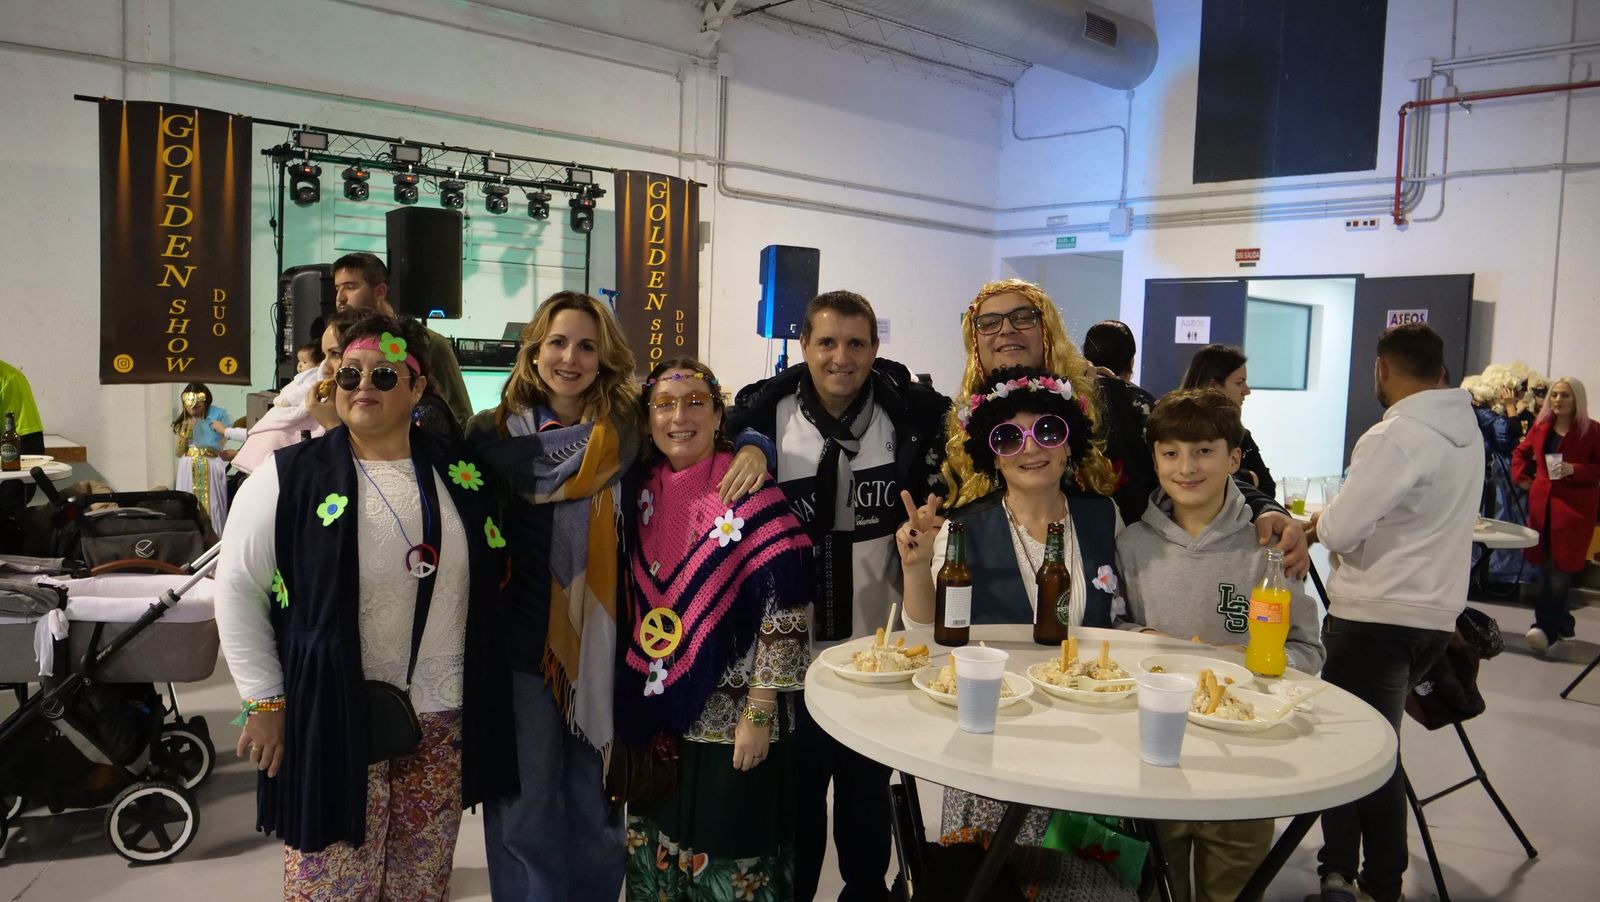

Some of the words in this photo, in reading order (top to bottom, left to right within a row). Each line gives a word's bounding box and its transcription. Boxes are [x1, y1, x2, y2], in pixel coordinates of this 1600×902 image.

[156, 114, 198, 289] GOLDEN
[644, 181, 668, 311] GOLDEN
[165, 299, 195, 373] SHOW
[212, 288, 226, 337] DUO
[675, 310, 684, 346] DUO
